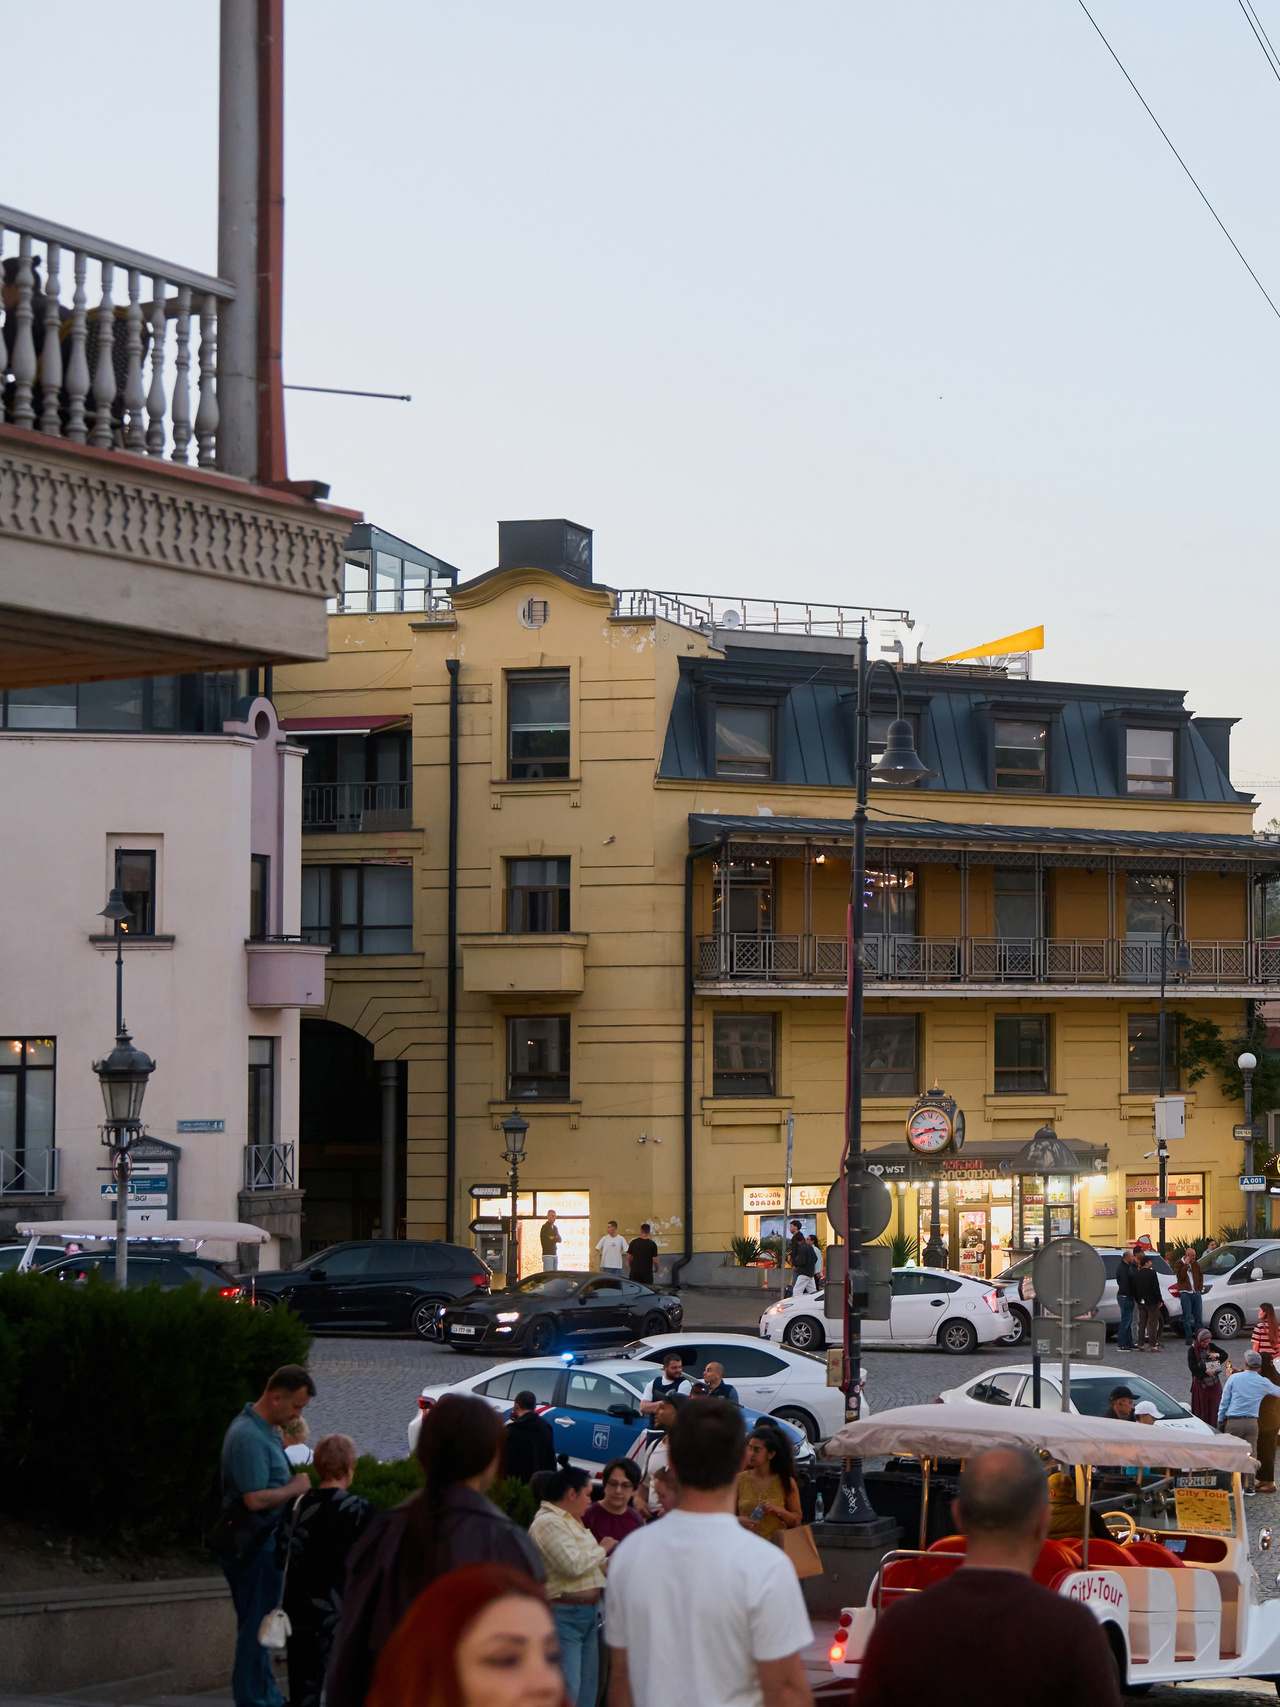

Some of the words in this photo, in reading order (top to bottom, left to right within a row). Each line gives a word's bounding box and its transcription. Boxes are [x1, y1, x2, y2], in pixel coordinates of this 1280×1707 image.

[867, 620, 929, 664] EY
[885, 1165, 906, 1174] WST
[799, 1189, 826, 1198] CITY
[749, 1199, 782, 1207] ტურები
[800, 1198, 826, 1206] TOUR
[1177, 1489, 1200, 1498] City
[1202, 1490, 1228, 1499] Tour
[1069, 1577, 1123, 1607] City-Tour
